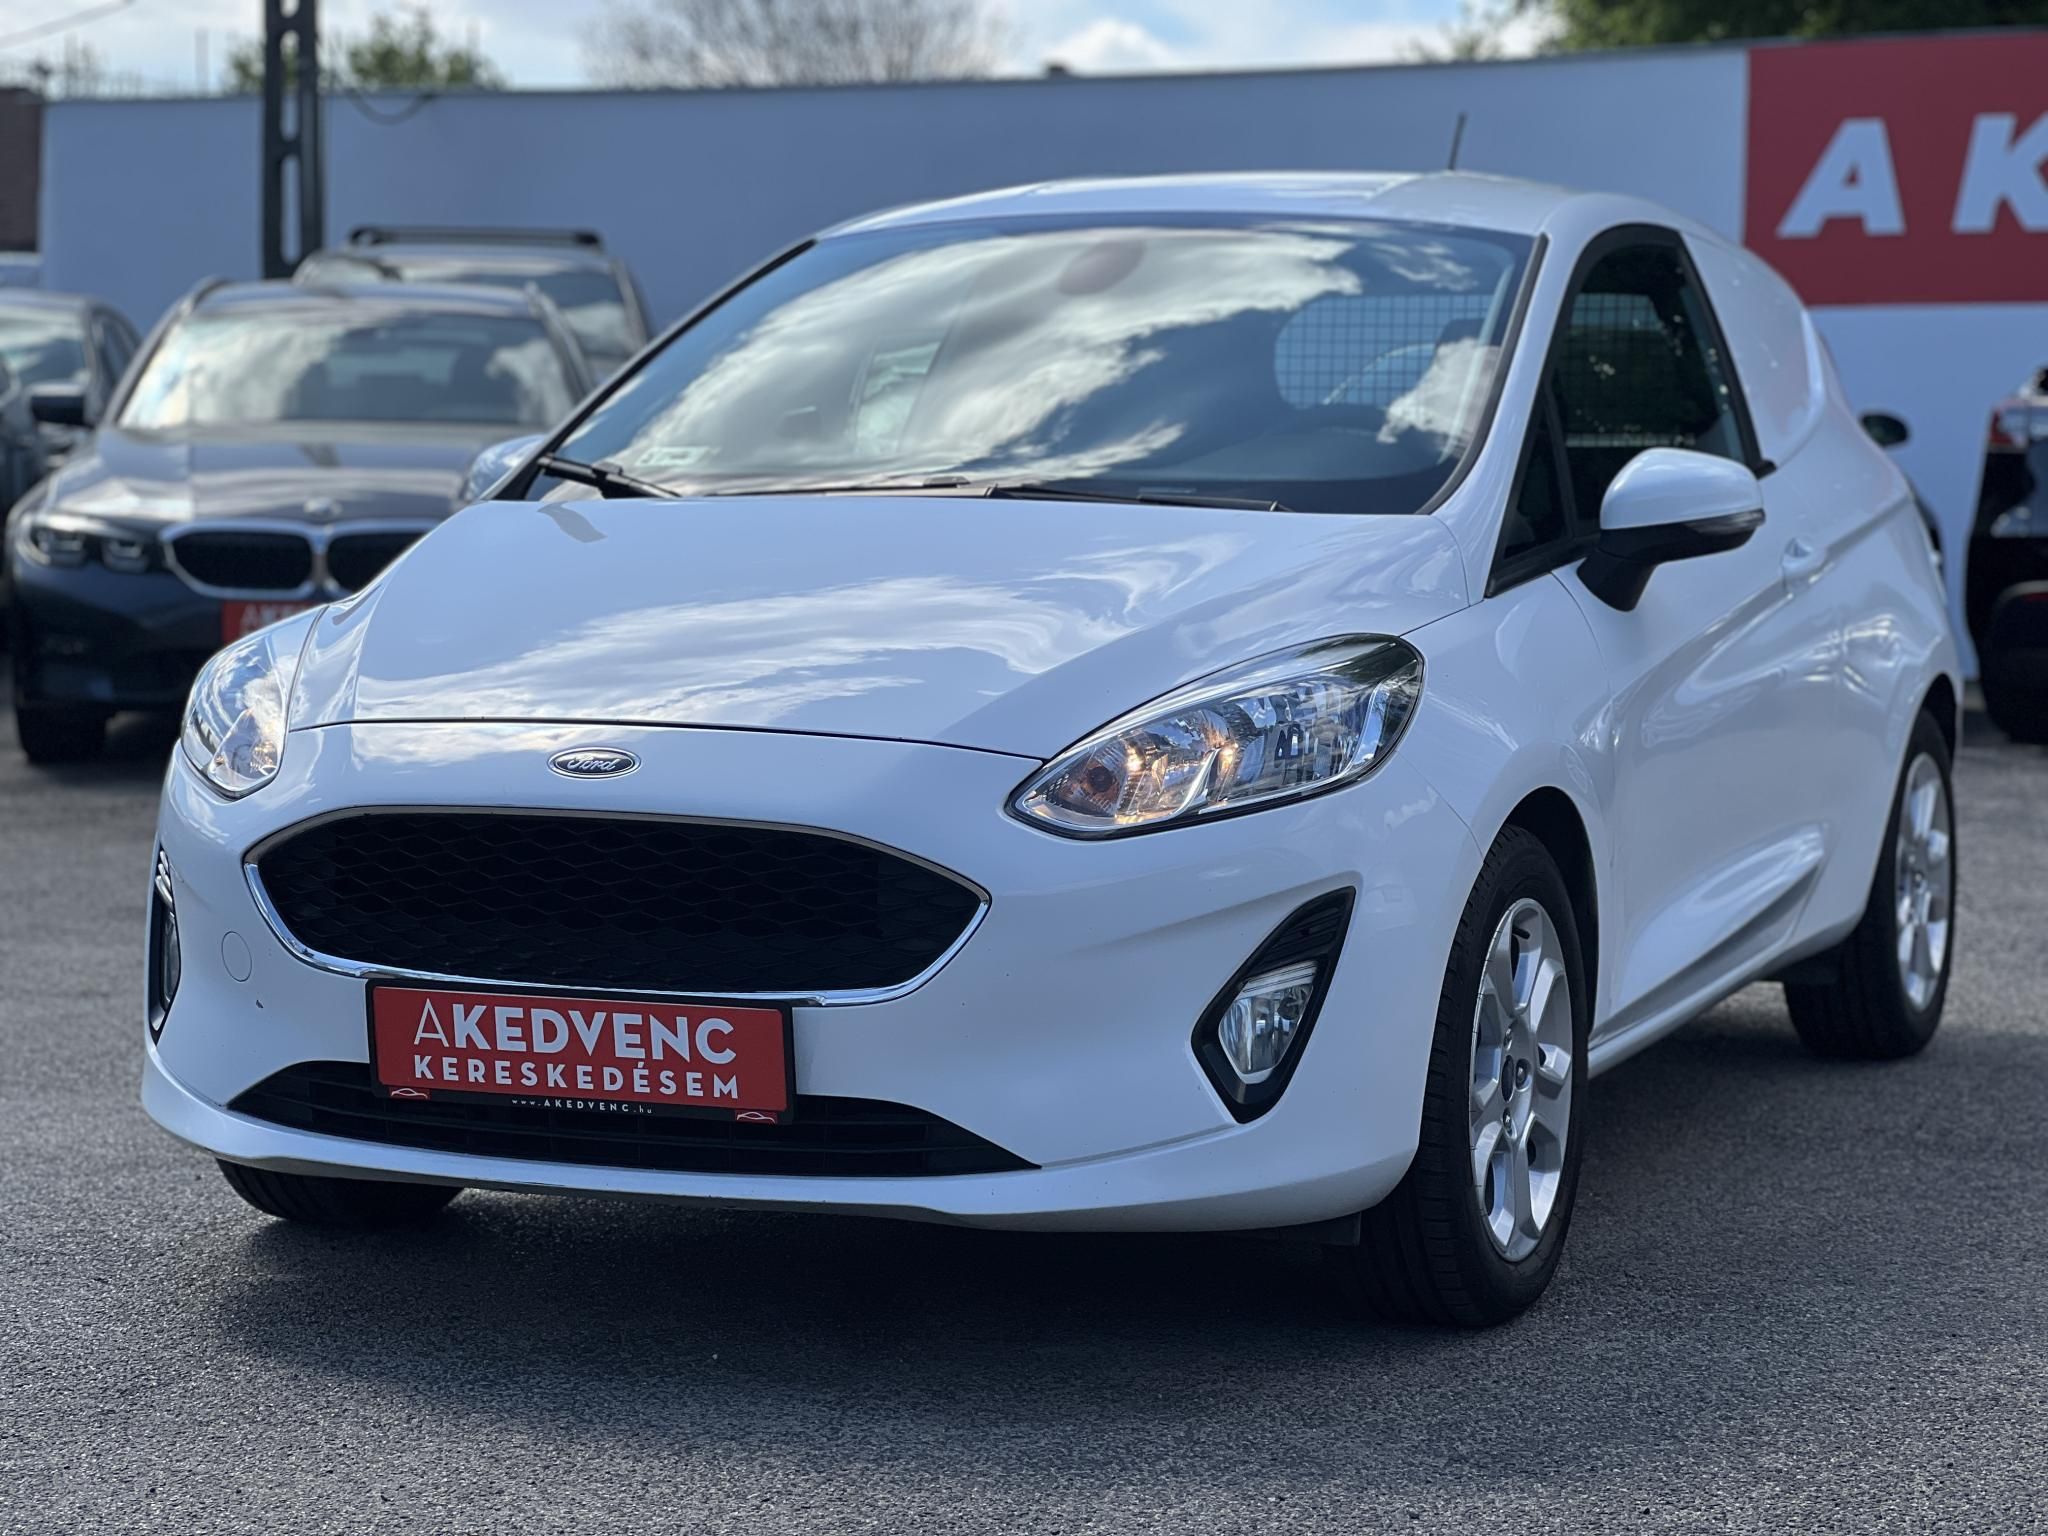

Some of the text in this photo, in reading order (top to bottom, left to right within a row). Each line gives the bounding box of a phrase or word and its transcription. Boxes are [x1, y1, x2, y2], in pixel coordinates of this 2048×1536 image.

[567, 754, 620, 771] Ford
[413, 997, 737, 1065] AKEDVENC
[413, 1053, 739, 1099] KERESKEDÉSEM
[511, 1098, 653, 1114] www.AKEDVENC.hu
